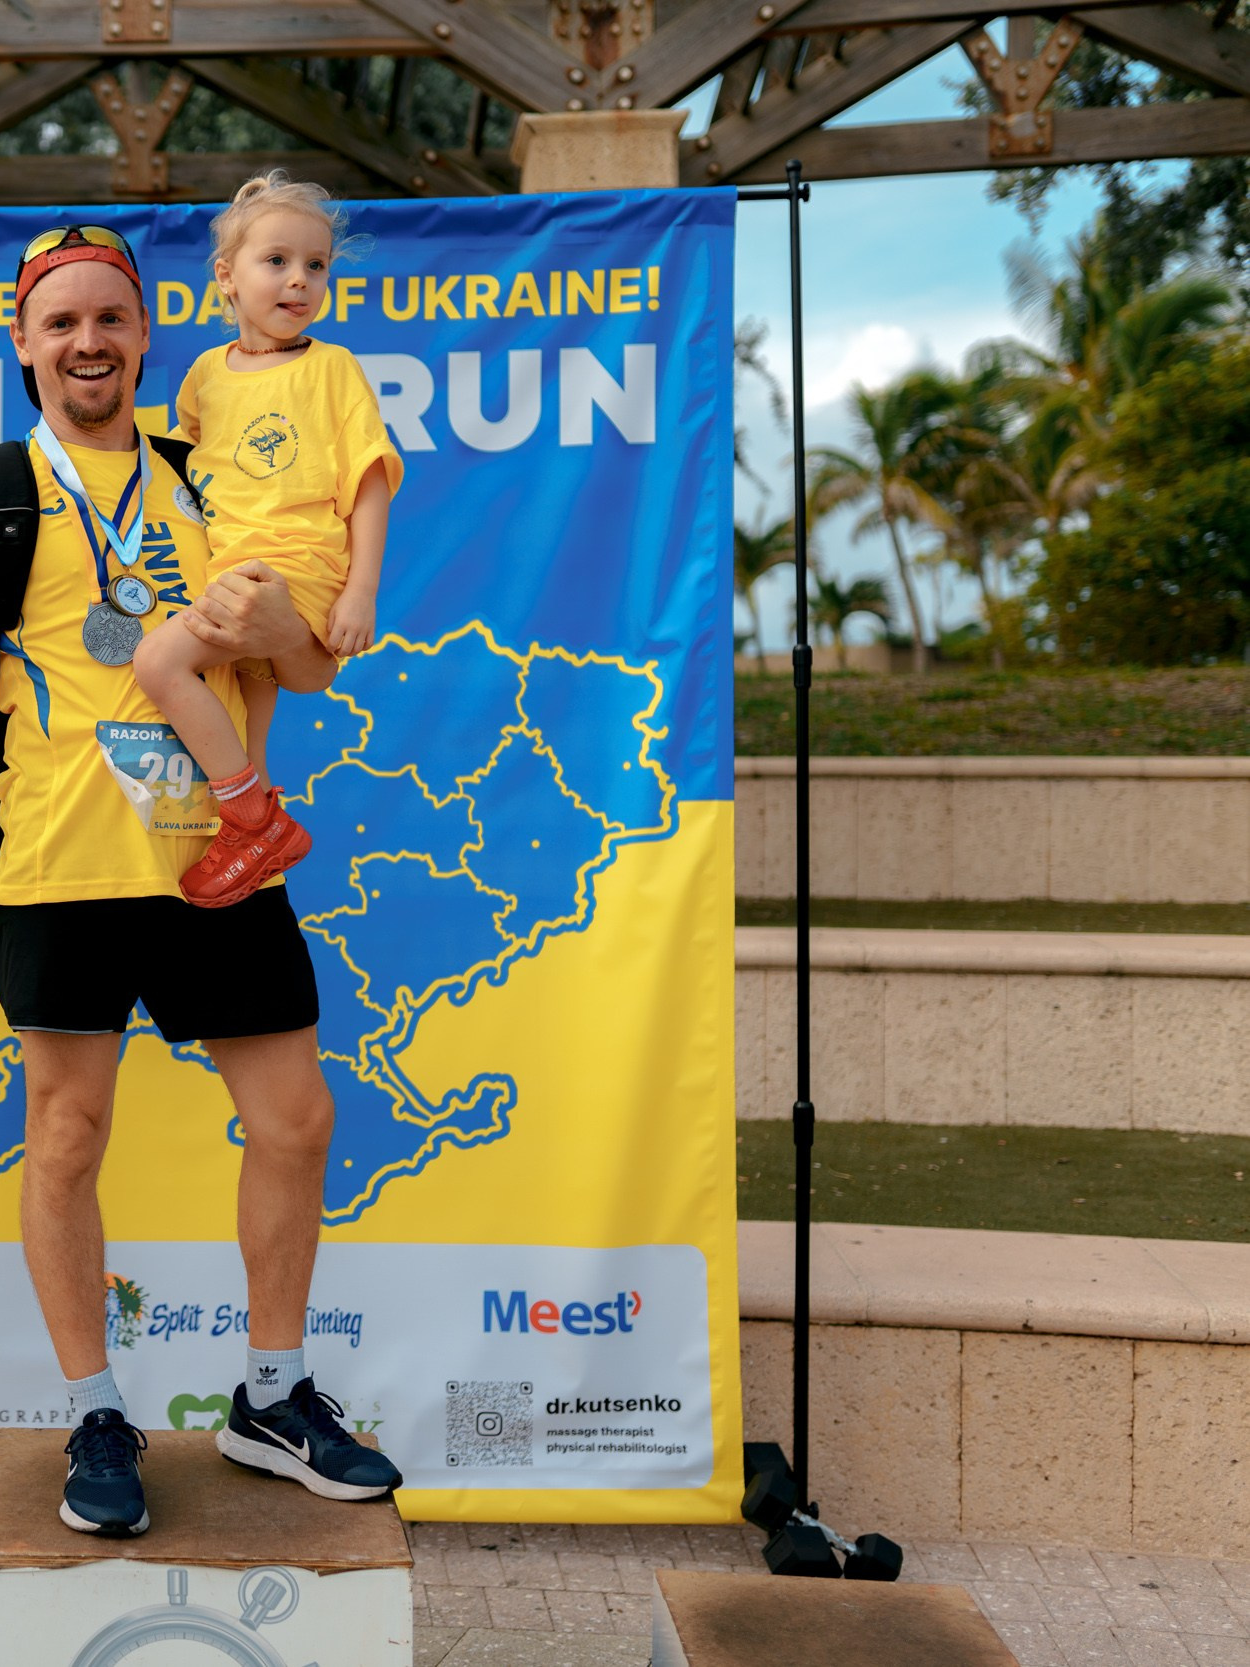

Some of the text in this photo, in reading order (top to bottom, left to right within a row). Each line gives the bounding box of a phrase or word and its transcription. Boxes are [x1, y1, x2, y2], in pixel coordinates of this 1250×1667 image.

[382, 266, 661, 321] UKRAINE!
[243, 413, 299, 441] RAZOM RUN
[110, 728, 163, 741] RAZOM
[139, 751, 193, 799] 29
[154, 821, 180, 830] SLAVA
[224, 858, 245, 881] NEW
[148, 1304, 205, 1342] Split
[483, 1290, 635, 1336] Meest
[546, 1394, 681, 1415] dr.kutsenko
[546, 1426, 654, 1439] massage therapist
[546, 1441, 688, 1455] physical rehabilitologist
